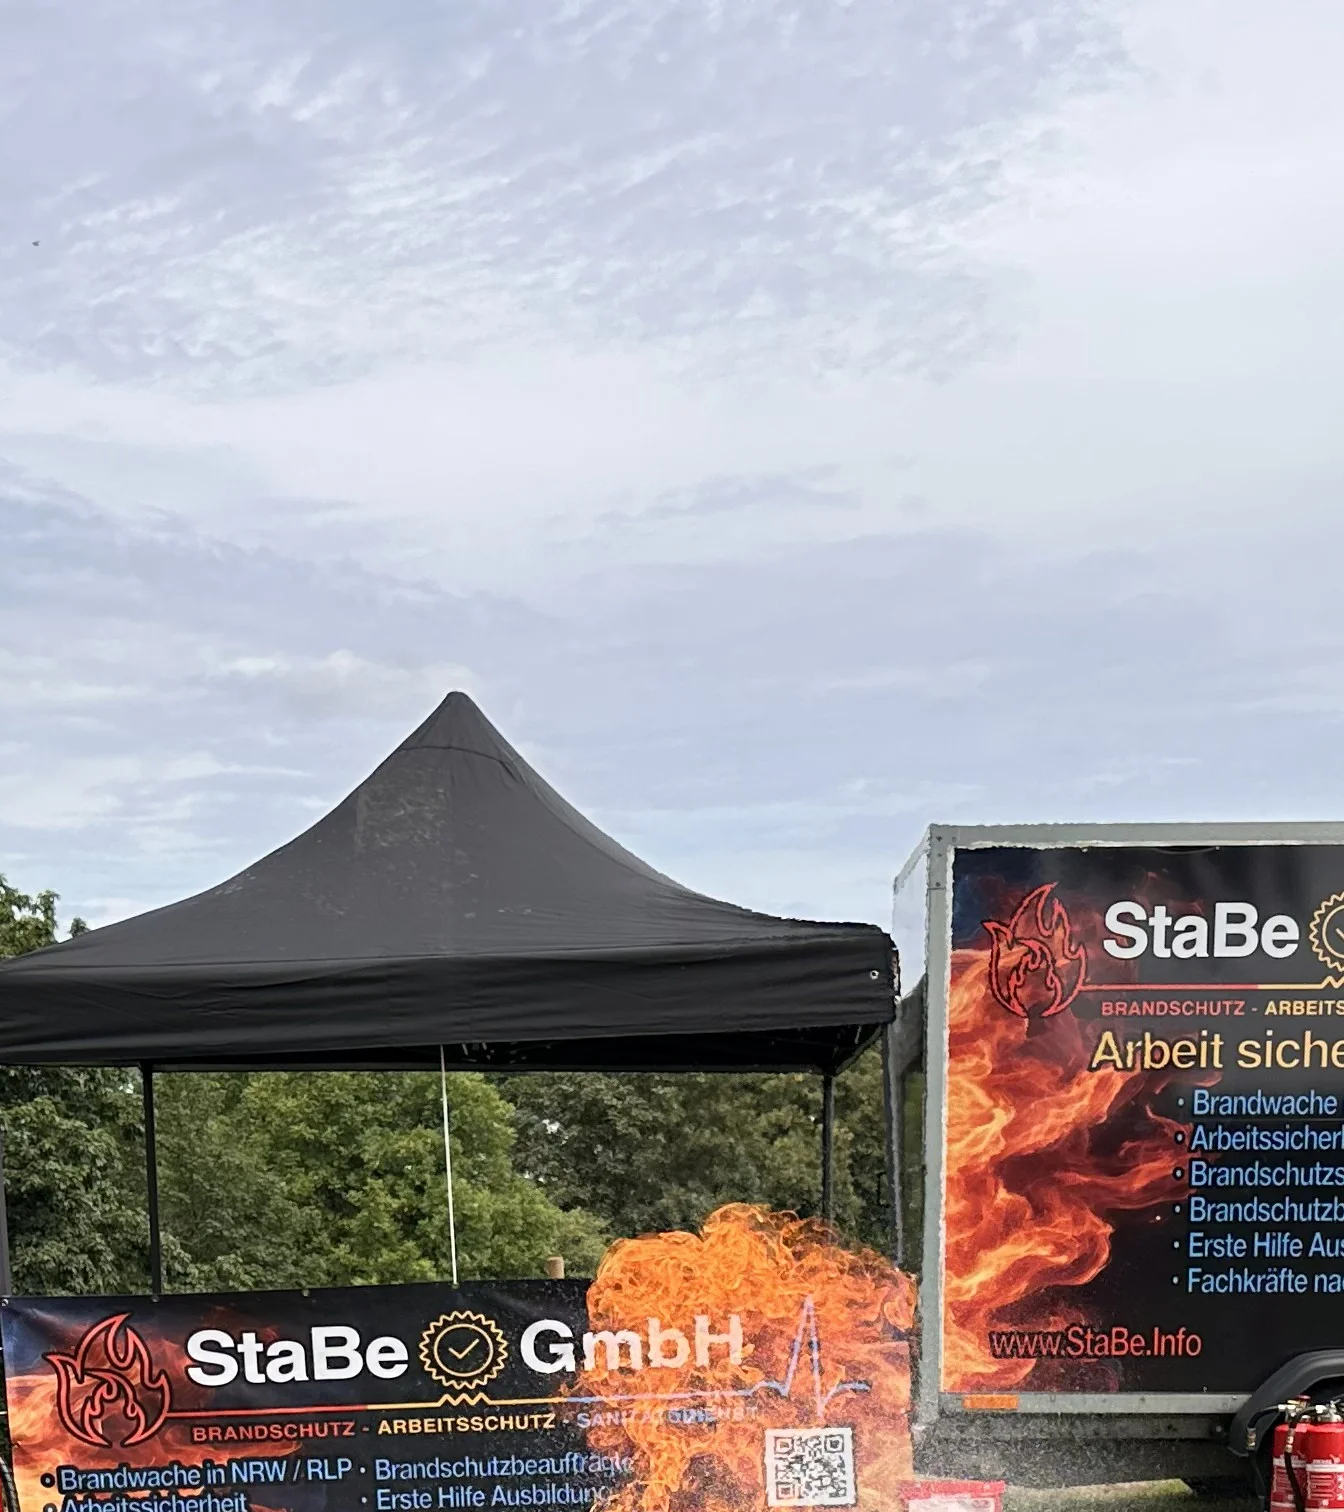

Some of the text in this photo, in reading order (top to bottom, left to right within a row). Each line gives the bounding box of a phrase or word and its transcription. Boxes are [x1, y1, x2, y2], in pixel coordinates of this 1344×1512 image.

[1103, 901, 1298, 959] StaBe
[1101, 1001, 1245, 1016] BRANDSCHUTZ
[1091, 1030, 1223, 1070] Arbeit
[1193, 1089, 1337, 1116] Brandwache
[1188, 1232, 1247, 1258] Erste
[1254, 1232, 1302, 1257] Hilfe
[1187, 1267, 1307, 1293] Fachkräfte
[186, 1314, 744, 1386] StaBe GmbH
[992, 1326, 1202, 1357] www.StaBe.Info
[193, 1421, 356, 1442] BRANDSCHUTZ
[378, 1414, 556, 1435] ARBEITSSCHUTZ
[61, 1458, 353, 1491] Brandwache in NRW / RLP
[377, 1489, 432, 1510] Erste
[438, 1486, 485, 1508] Hilfe
